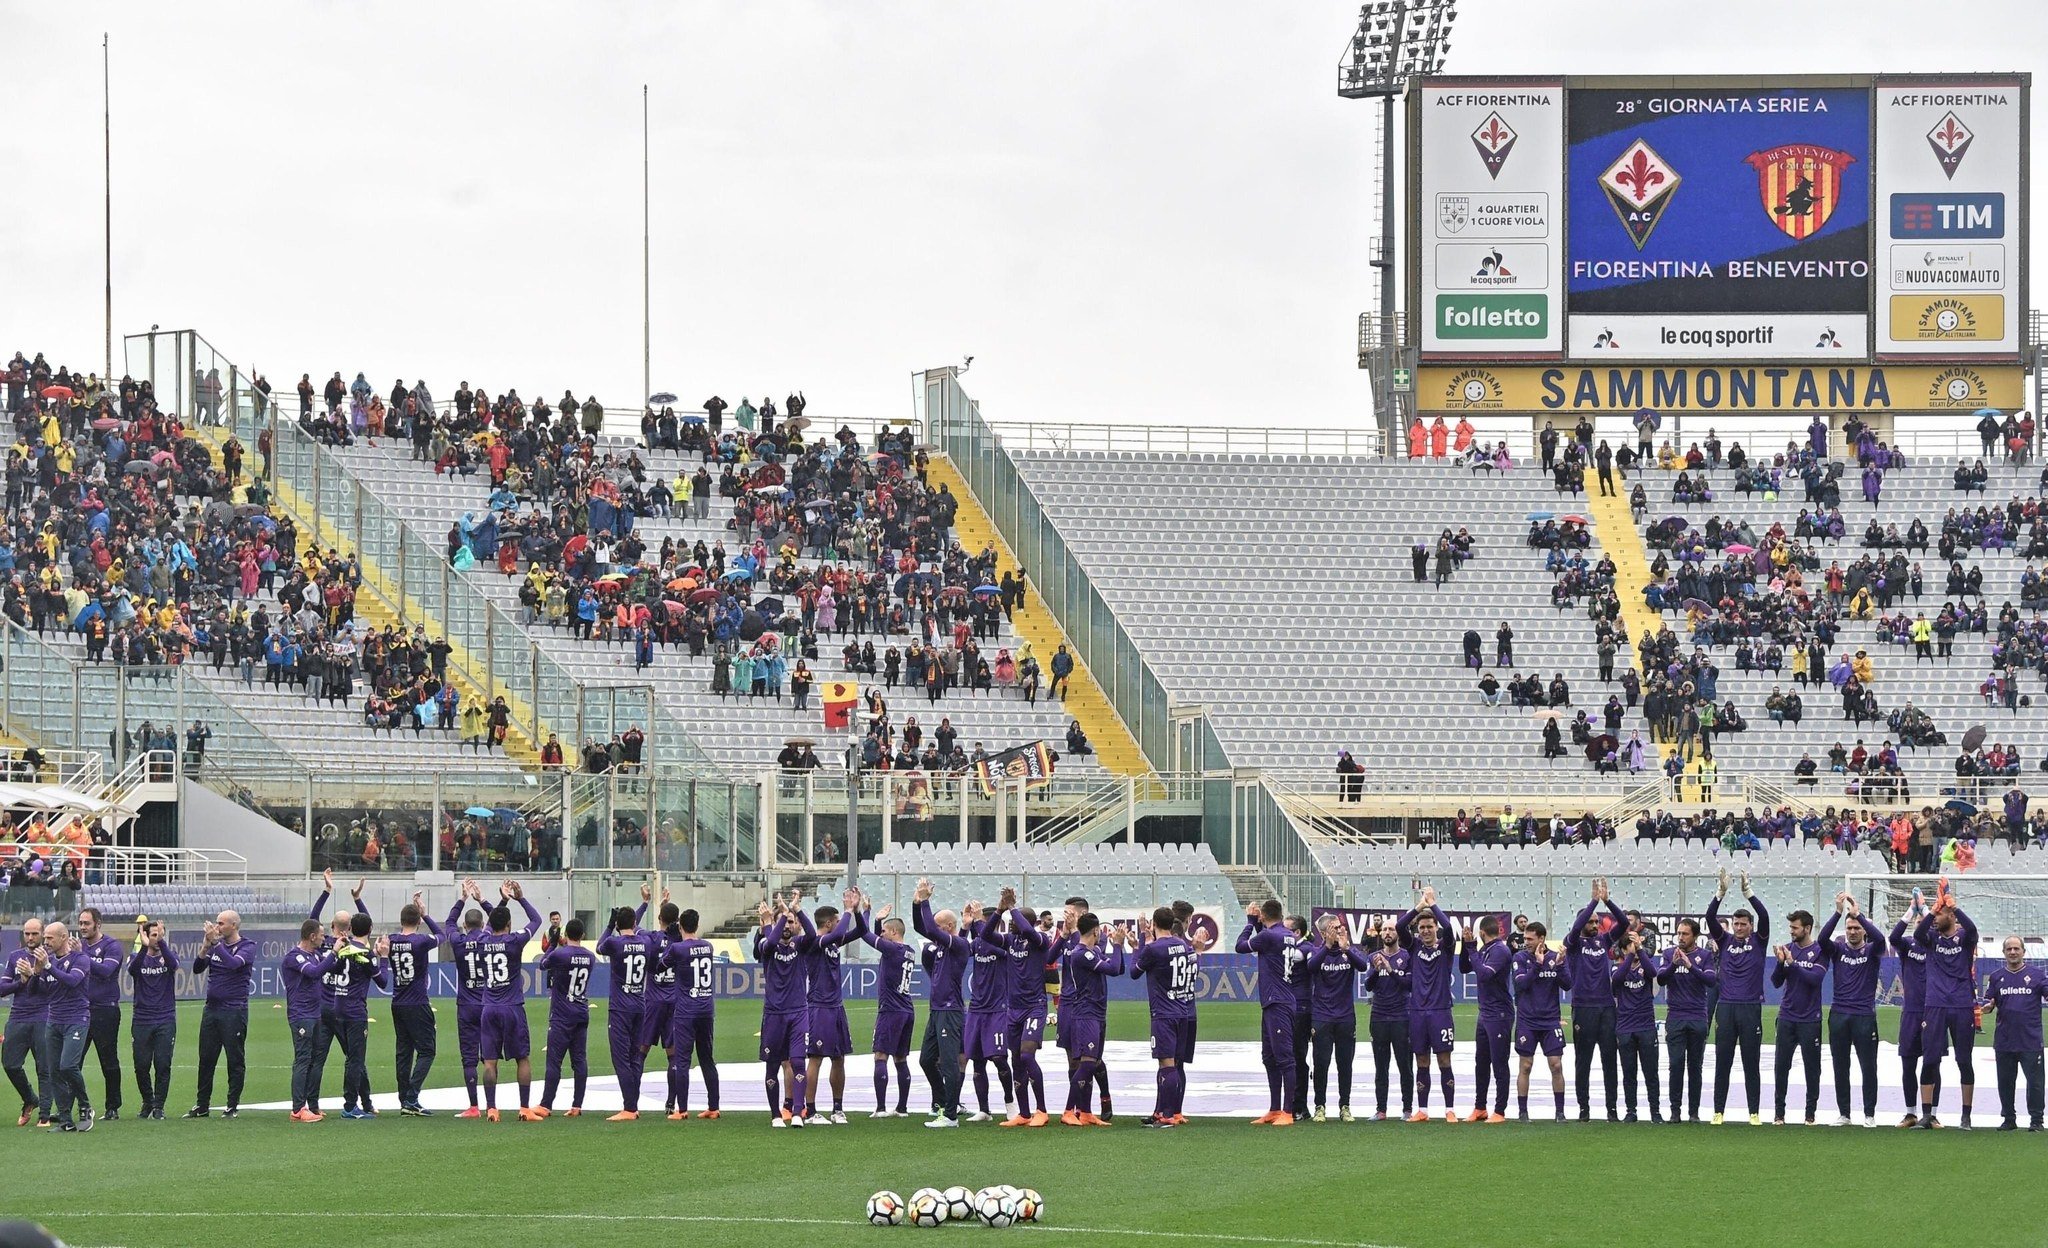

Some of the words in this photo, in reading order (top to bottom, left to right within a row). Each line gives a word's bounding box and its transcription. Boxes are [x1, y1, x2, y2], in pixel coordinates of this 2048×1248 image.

[1436, 95, 1463, 106] ACF
[1466, 95, 1551, 106] FIORENTINA
[1616, 98, 1642, 114] 28°
[1648, 97, 1753, 113] GIORNATA
[1757, 97, 1809, 113] SERIE
[1813, 97, 1829, 113] A
[1891, 95, 1919, 107] ACF
[1921, 94, 2008, 106] FIORENTINA
[1767, 147, 1834, 161] BENEVENTO
[1477, 205, 1484, 214] 4
[1485, 205, 1539, 214] QUARTIERI
[1937, 204, 1992, 229] TIM
[1471, 217, 1476, 226] 1
[1478, 217, 1512, 226] CUORE
[1514, 217, 1545, 226] VIOLA
[1574, 261, 1714, 279] FIORENTINA
[1728, 260, 1869, 279] BENEVENTO
[1905, 270, 2000, 283] NUOVACOMAUTO
[1470, 276, 1478, 284] le
[1478, 277, 1492, 286] coq
[1493, 276, 1517, 286] sportif
[1444, 306, 1541, 327] folletto
[1918, 299, 1976, 327] SAMMONTANA
[1661, 326, 1677, 344] le
[1680, 330, 1713, 348] coq
[1715, 326, 1774, 348] sportif
[1446, 369, 1503, 397] SAMMONTANA
[1541, 369, 1892, 408] SAMMONTANA
[1929, 367, 1988, 396] SAMMONTANA
[391, 942, 413, 952] ASTORI
[483, 943, 506, 952] ASTORI
[623, 943, 646, 953] ASTORI
[689, 946, 711, 956] ASTORI
[391, 952, 415, 982] 13
[484, 952, 509, 984] 13
[570, 955, 591, 966] ASTORI
[1321, 962, 1351, 972] folletto
[623, 954, 647, 985] 13
[690, 957, 712, 988] 13
[1169, 955, 1187, 988] 13
[568, 967, 590, 998] 13
[1025, 1017, 1038, 1031] 14
[994, 1032, 1004, 1046] 11
[1440, 1029, 1454, 1042] 25
